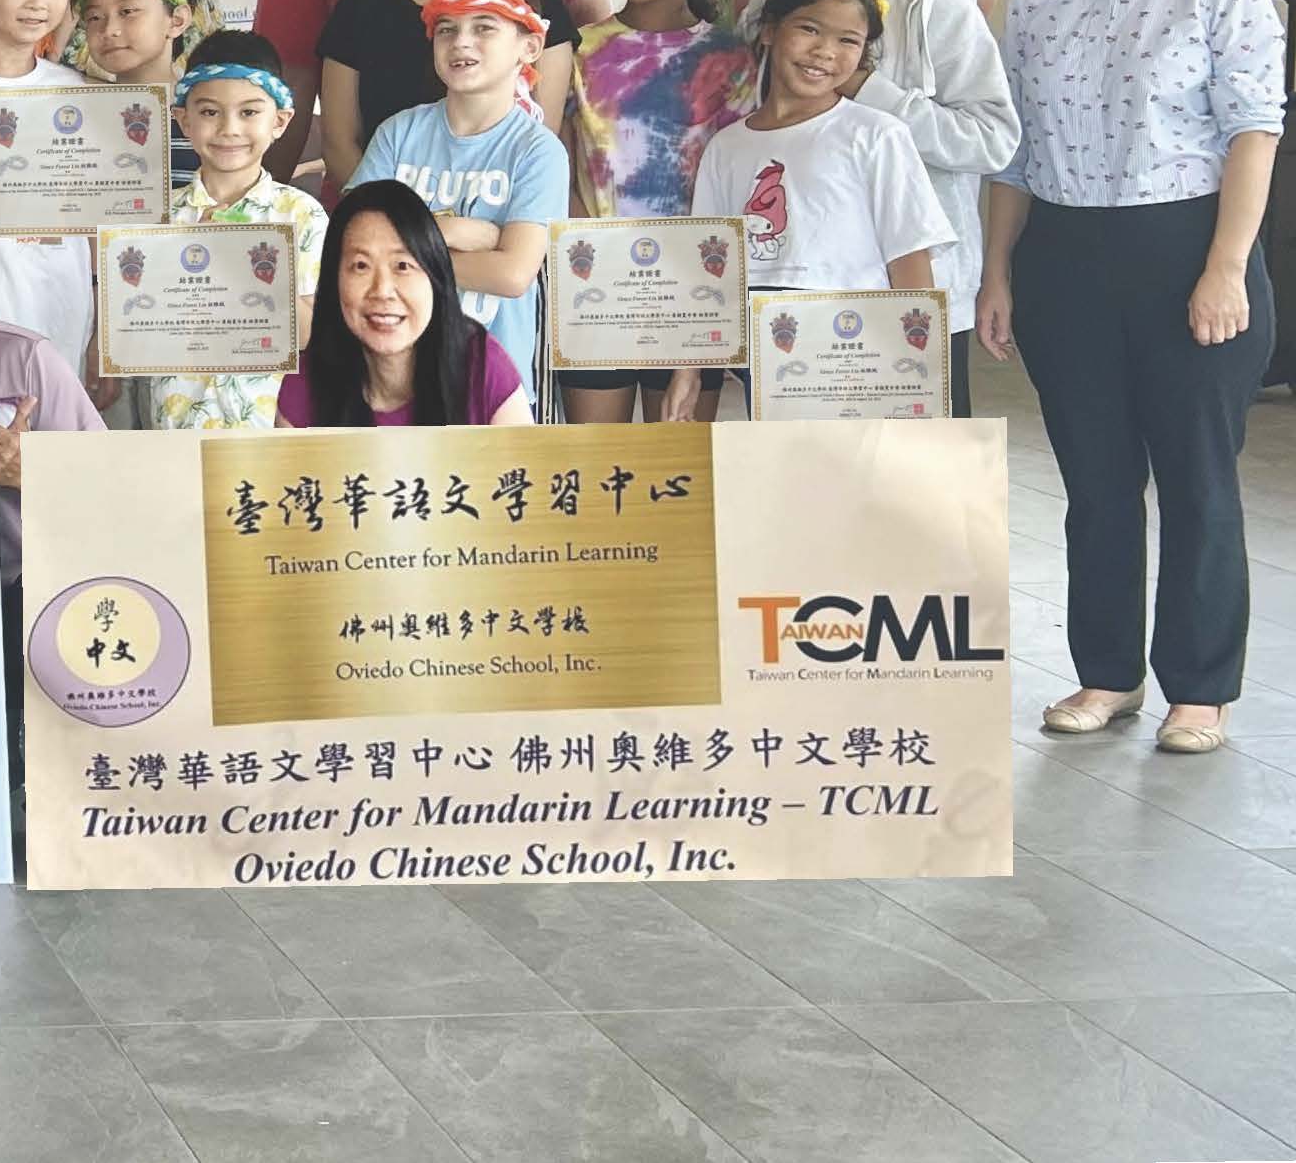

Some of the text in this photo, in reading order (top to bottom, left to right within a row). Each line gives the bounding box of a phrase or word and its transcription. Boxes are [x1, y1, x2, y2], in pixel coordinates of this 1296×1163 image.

[396, 163, 509, 206] PLUTO
[227, 465, 692, 535] 臺灣華語文學習中心
[266, 541, 658, 575] Taiwan Center for Mandarin Learning
[738, 595, 1005, 663] TCML
[86, 638, 136, 668] 中文
[336, 654, 602, 681] Oviedo Chinese School, Inc.
[748, 668, 993, 682] Taiwan Center for Mandarin Learning
[85, 728, 937, 791] 臺灣華語文學習中心 佛州奧維多中文學校
[82, 806, 207, 837] Taiwan
[221, 803, 339, 834] Center
[343, 797, 402, 837] for
[412, 792, 592, 826] Mandarin
[604, 788, 771, 826] Learning
[818, 784, 939, 817] TCML
[234, 839, 737, 885] Oviedo Chinese School, Inc.
